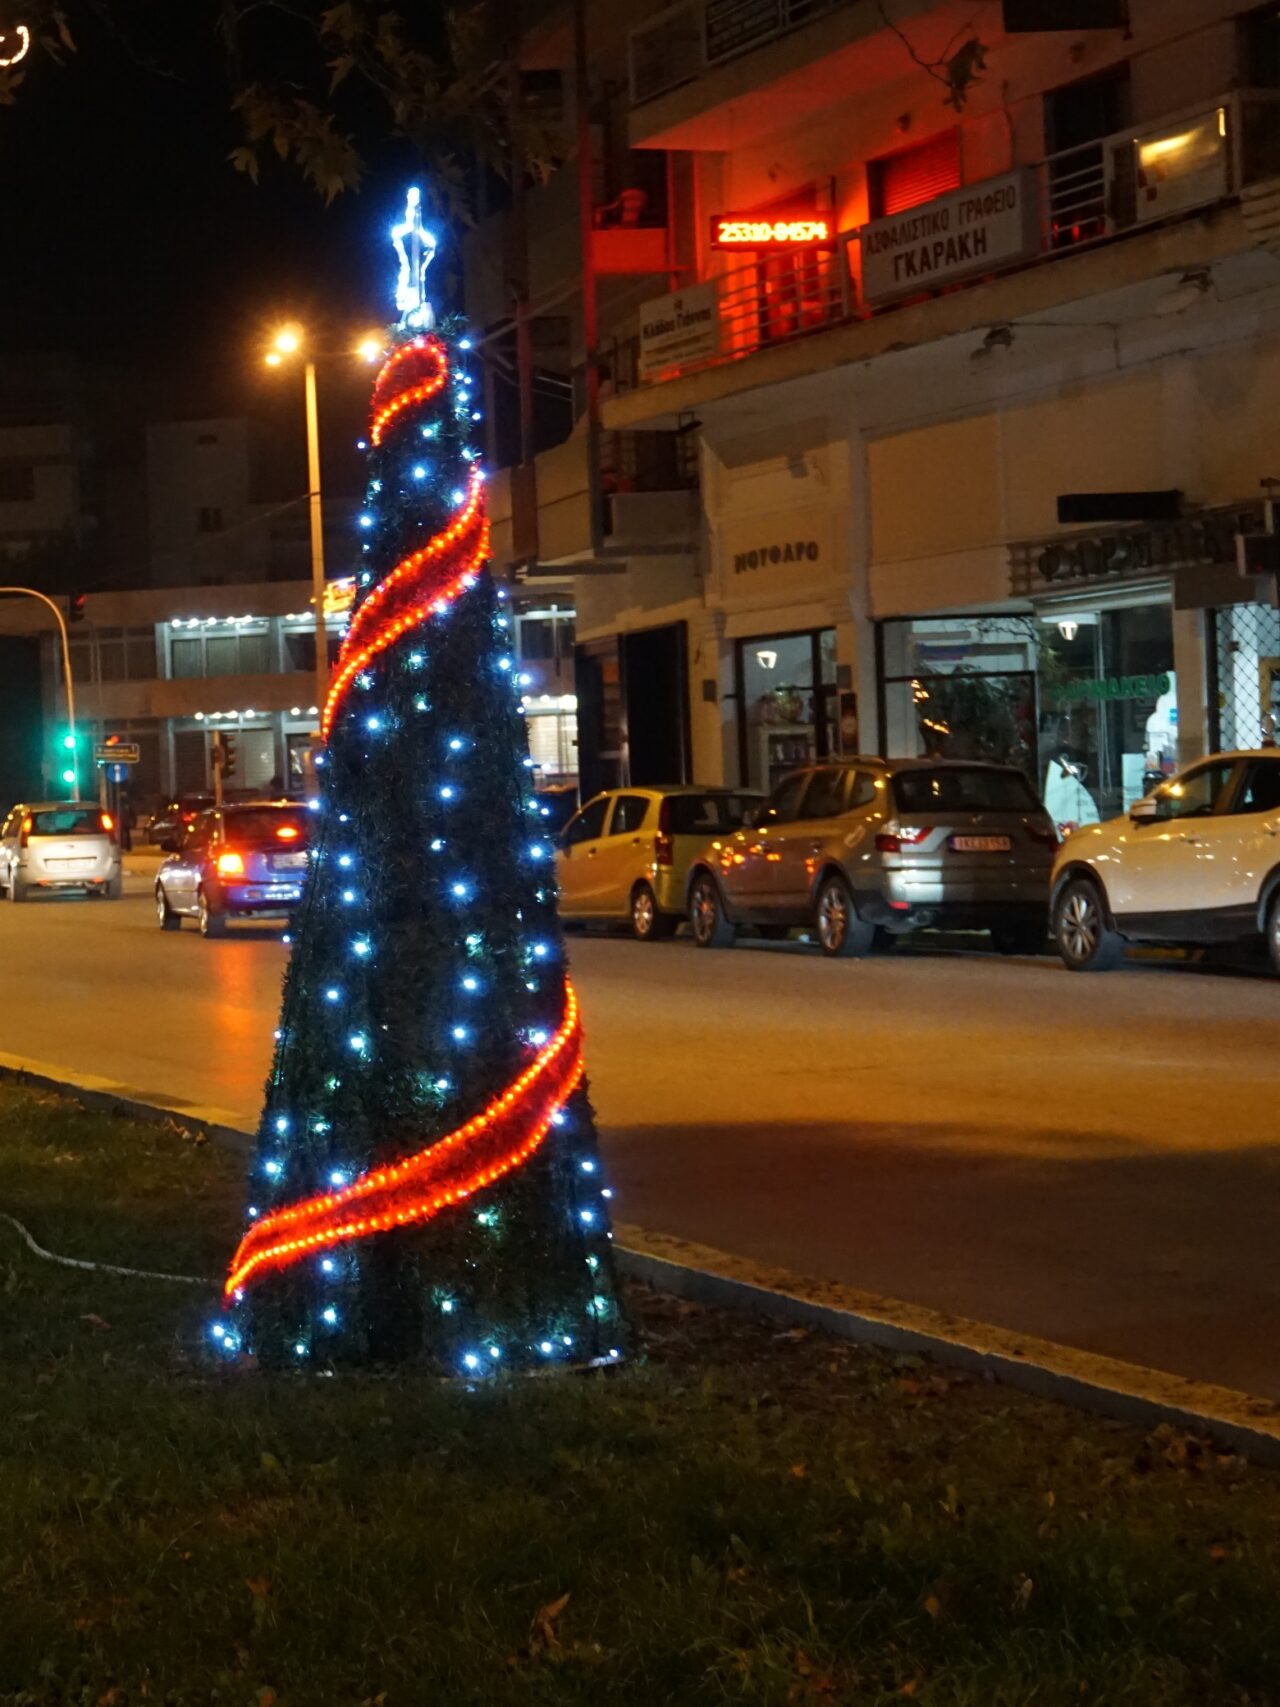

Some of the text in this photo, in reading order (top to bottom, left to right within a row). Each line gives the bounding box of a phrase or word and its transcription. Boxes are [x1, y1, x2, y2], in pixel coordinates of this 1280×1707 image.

[865, 184, 1017, 257] ΑΣΦΑΛΙΣΤΙΚΟ ΓΡΑΦΕΙΟ
[892, 226, 988, 282] ΓΚΑΡΑΚΗ
